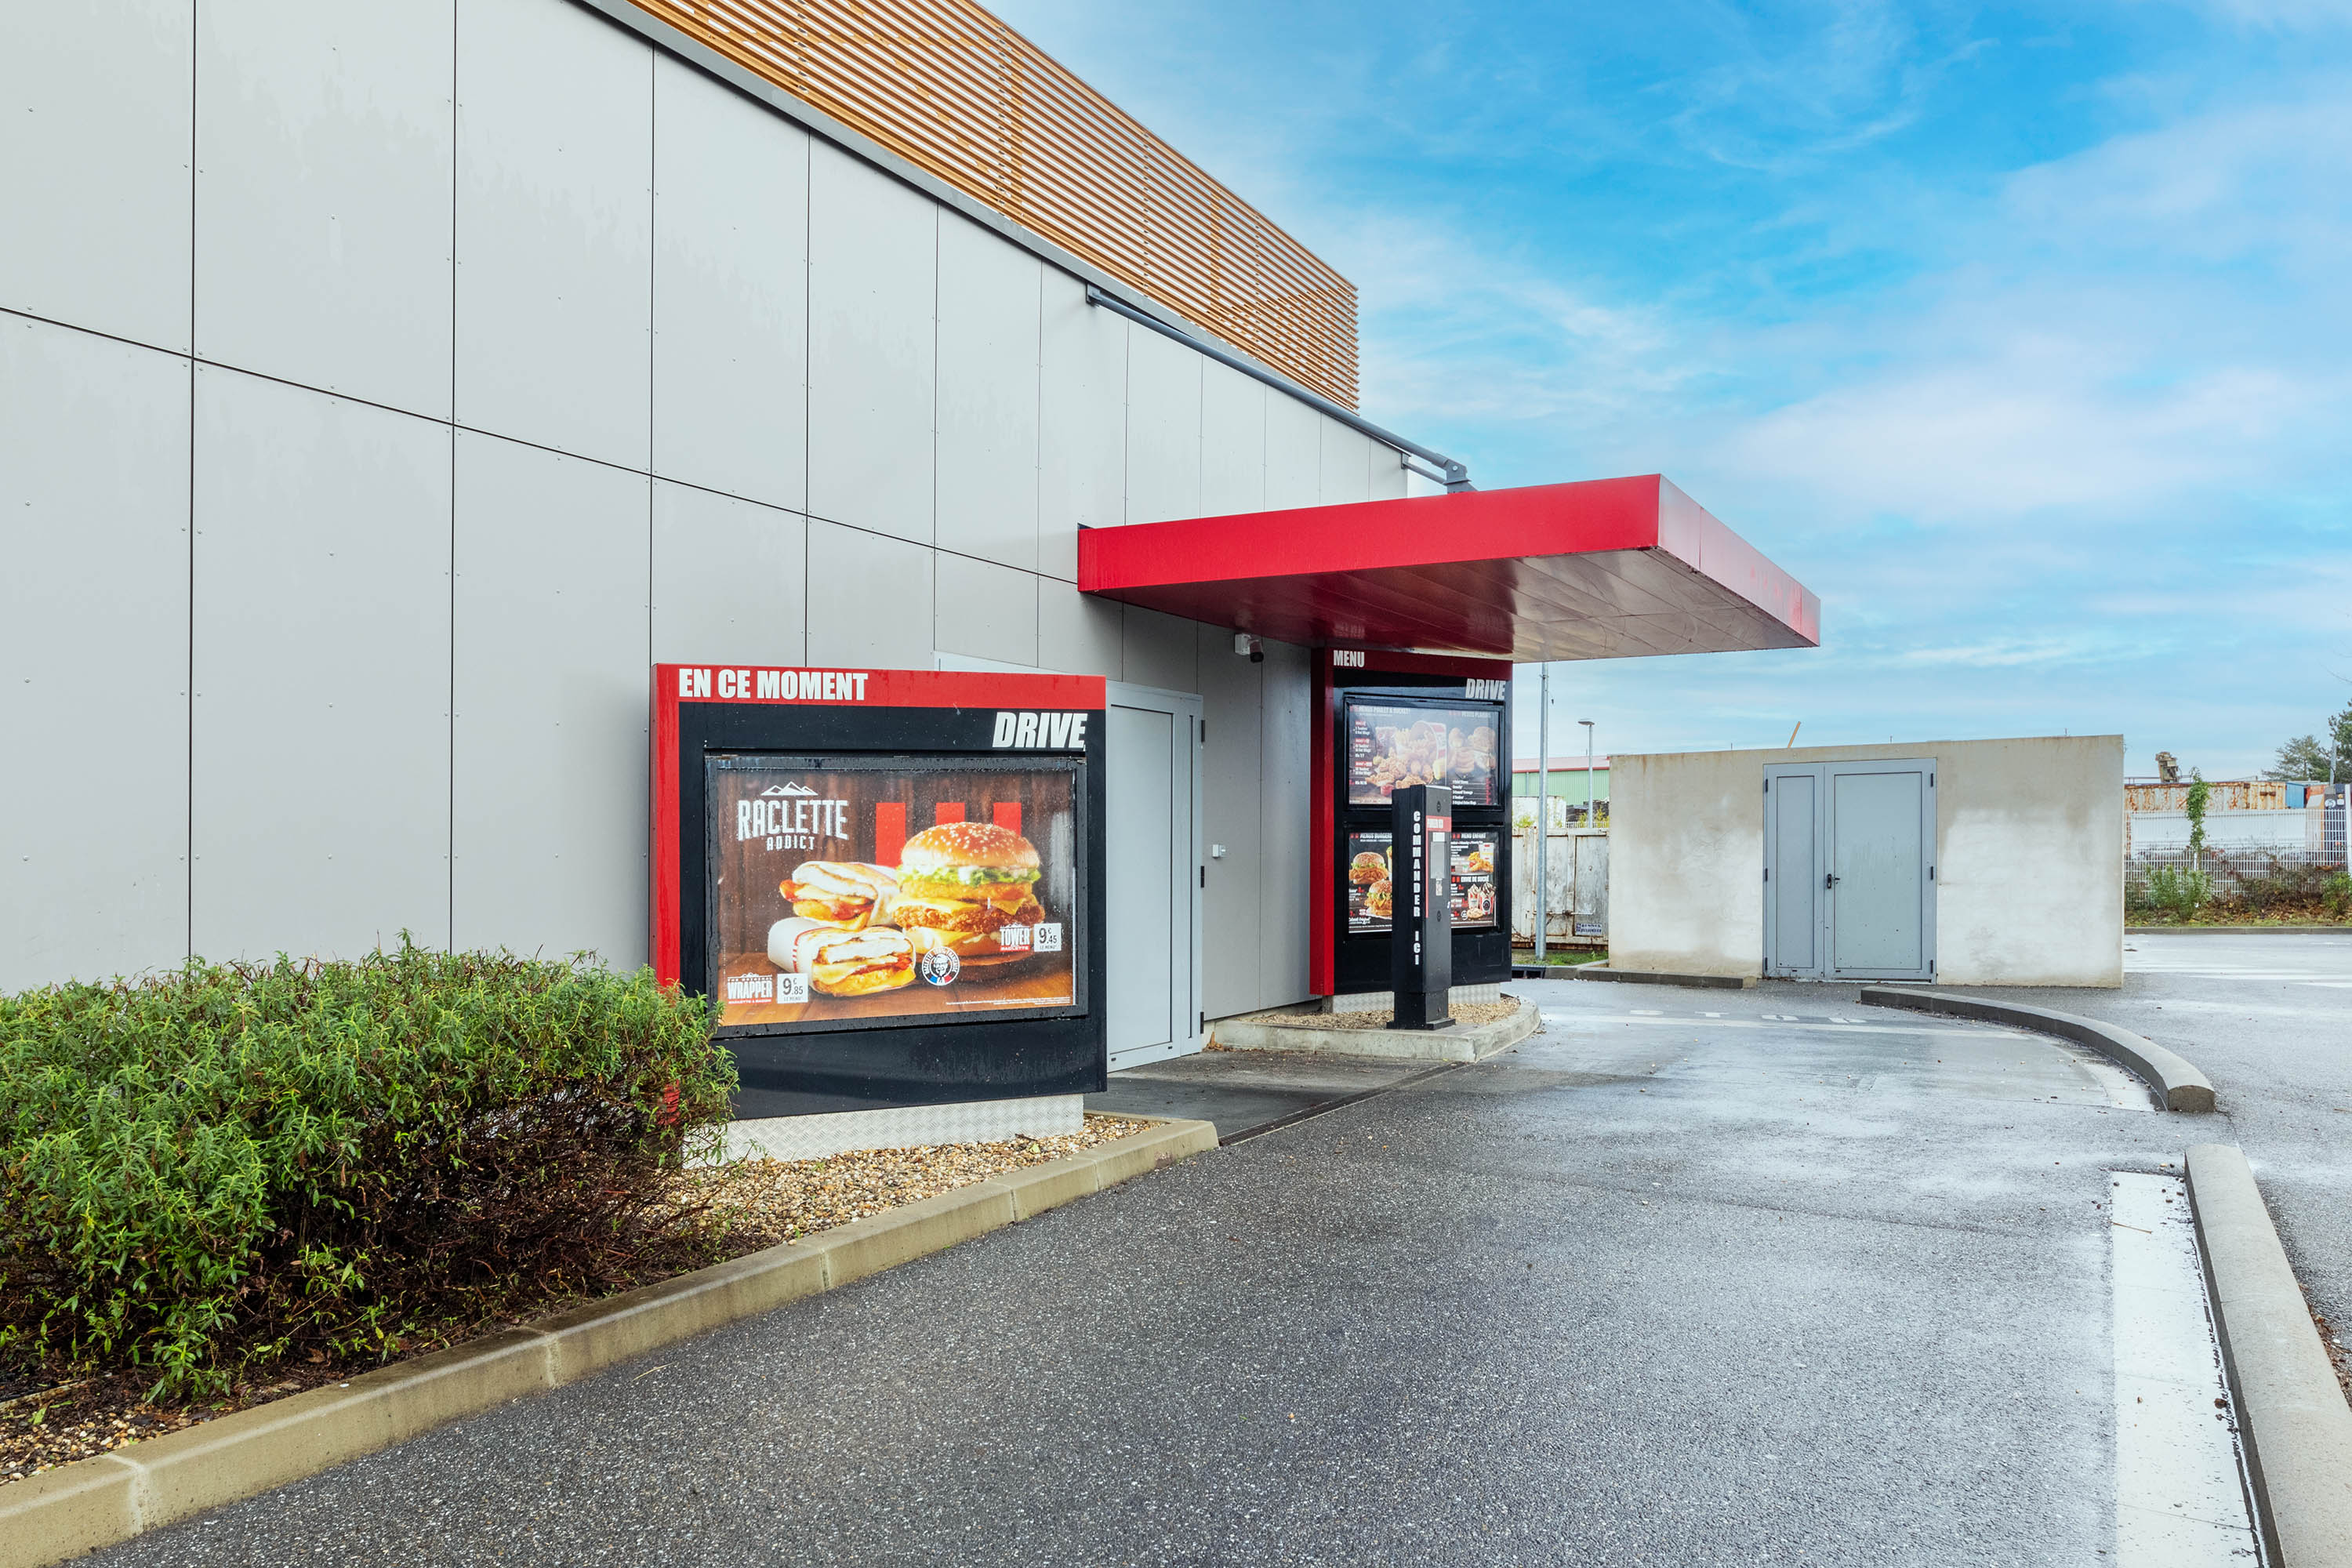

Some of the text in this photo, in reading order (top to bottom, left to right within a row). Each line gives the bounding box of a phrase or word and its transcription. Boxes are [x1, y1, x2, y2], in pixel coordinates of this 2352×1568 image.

[1334, 650, 1365, 667] MENU
[679, 669, 869, 700] EN CE MOMENT
[1466, 678, 1506, 699] DRIVE
[992, 711, 1088, 749] DRIVE
[738, 799, 849, 841] RACLETTE
[767, 836, 815, 851] ADDICT
[1413, 811, 1421, 917] COMMANDER
[1000, 928, 1030, 946] TOWER
[728, 981, 772, 1000] WRAPPER
